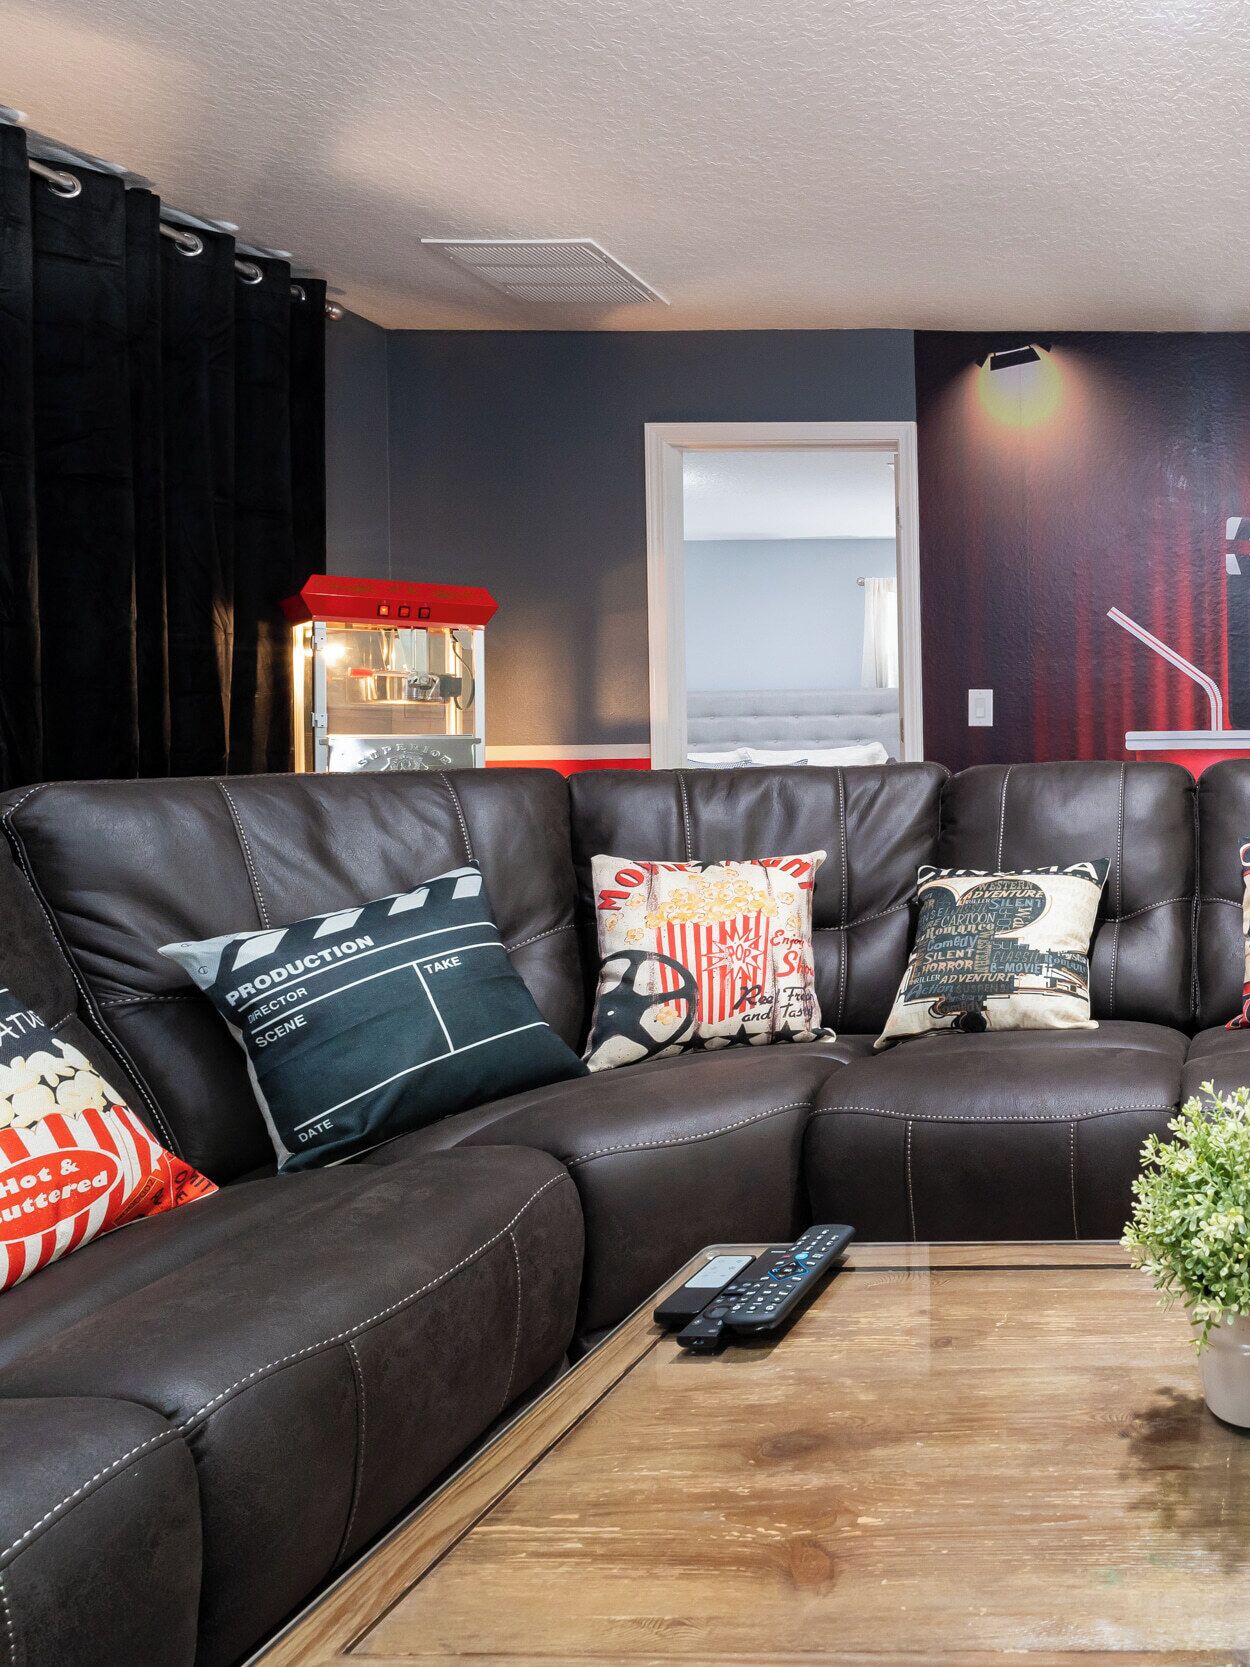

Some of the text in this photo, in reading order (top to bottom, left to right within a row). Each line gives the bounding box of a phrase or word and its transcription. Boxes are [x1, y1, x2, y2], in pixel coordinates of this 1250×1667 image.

[357, 743, 453, 767] SUPERIOR
[977, 880, 1034, 891] WESTERN
[963, 889, 1045, 901] ADVENTURE
[940, 911, 999, 928] CARTOON
[925, 923, 995, 939] Romance
[926, 934, 979, 952] Comedy
[726, 943, 752, 964] POP
[924, 948, 975, 965] SILENT
[225, 934, 375, 1007] PRODUCTION
[422, 955, 463, 977] TAKE
[922, 960, 975, 976] HORROR
[990, 962, 1041, 975] B-MOVIE
[904, 982, 954, 1000] Action
[246, 987, 308, 1025] DIRECTOR
[741, 1005, 773, 1023] and
[255, 1014, 308, 1048] SCENE
[297, 1118, 334, 1144] DATE
[0, 1158, 81, 1199] Hot &
[0, 1170, 108, 1224] uttered
